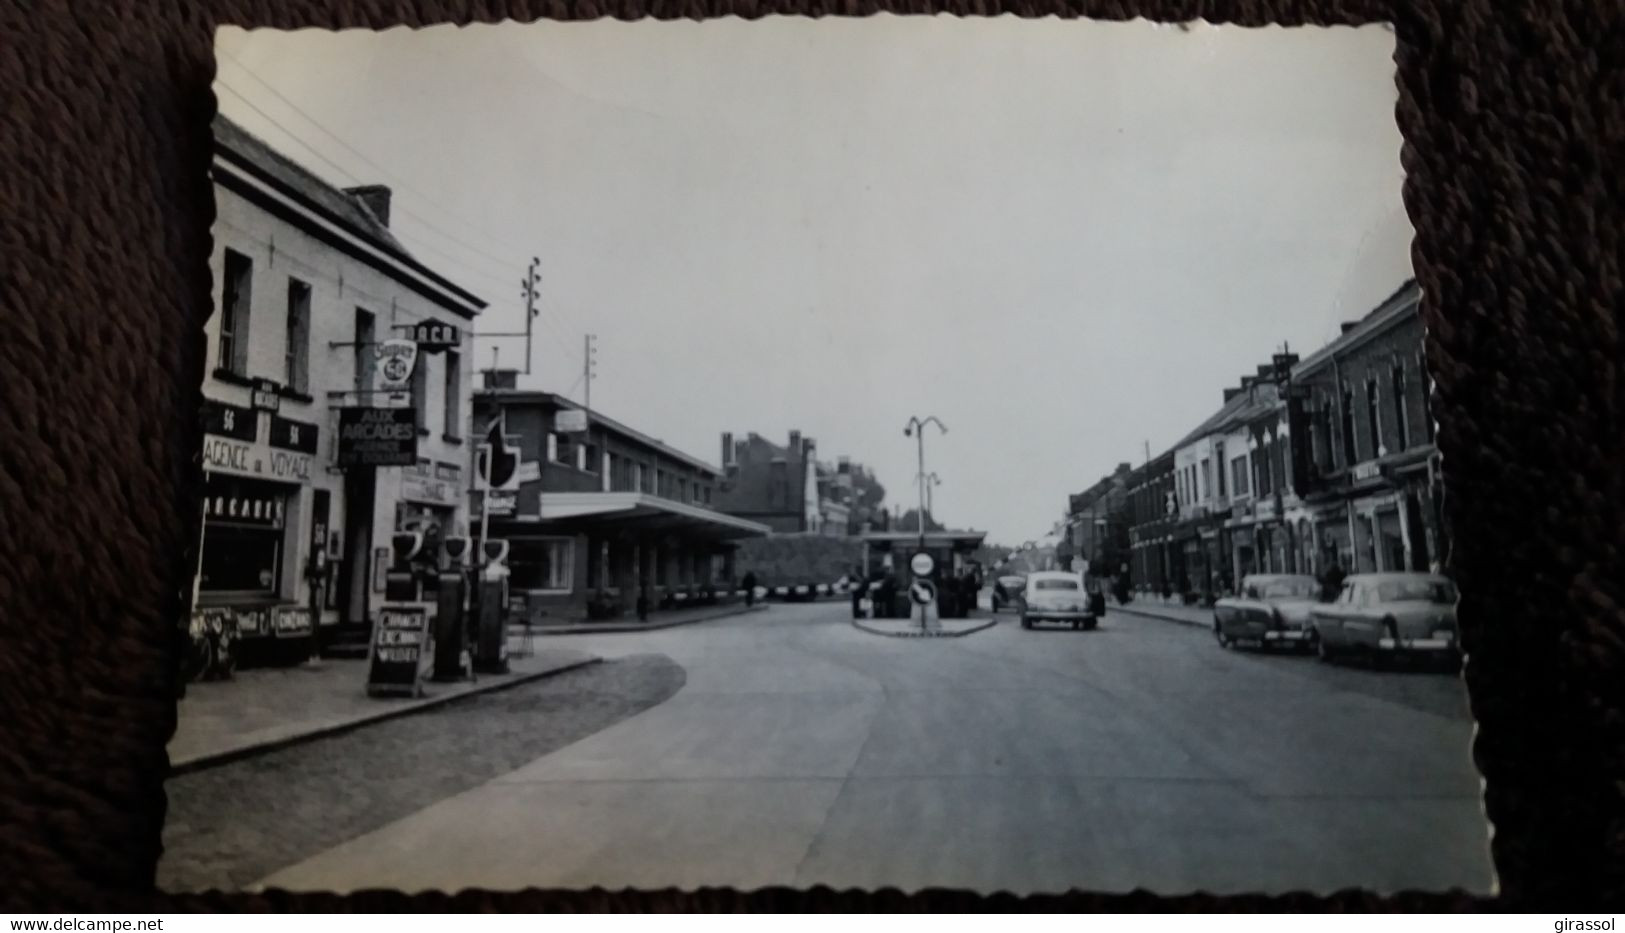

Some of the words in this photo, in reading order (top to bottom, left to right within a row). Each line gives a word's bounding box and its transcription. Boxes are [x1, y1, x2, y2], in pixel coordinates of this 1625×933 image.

[361, 409, 395, 424] AUX
[342, 422, 413, 441] ARCADES
[203, 440, 249, 471] AGENCE
